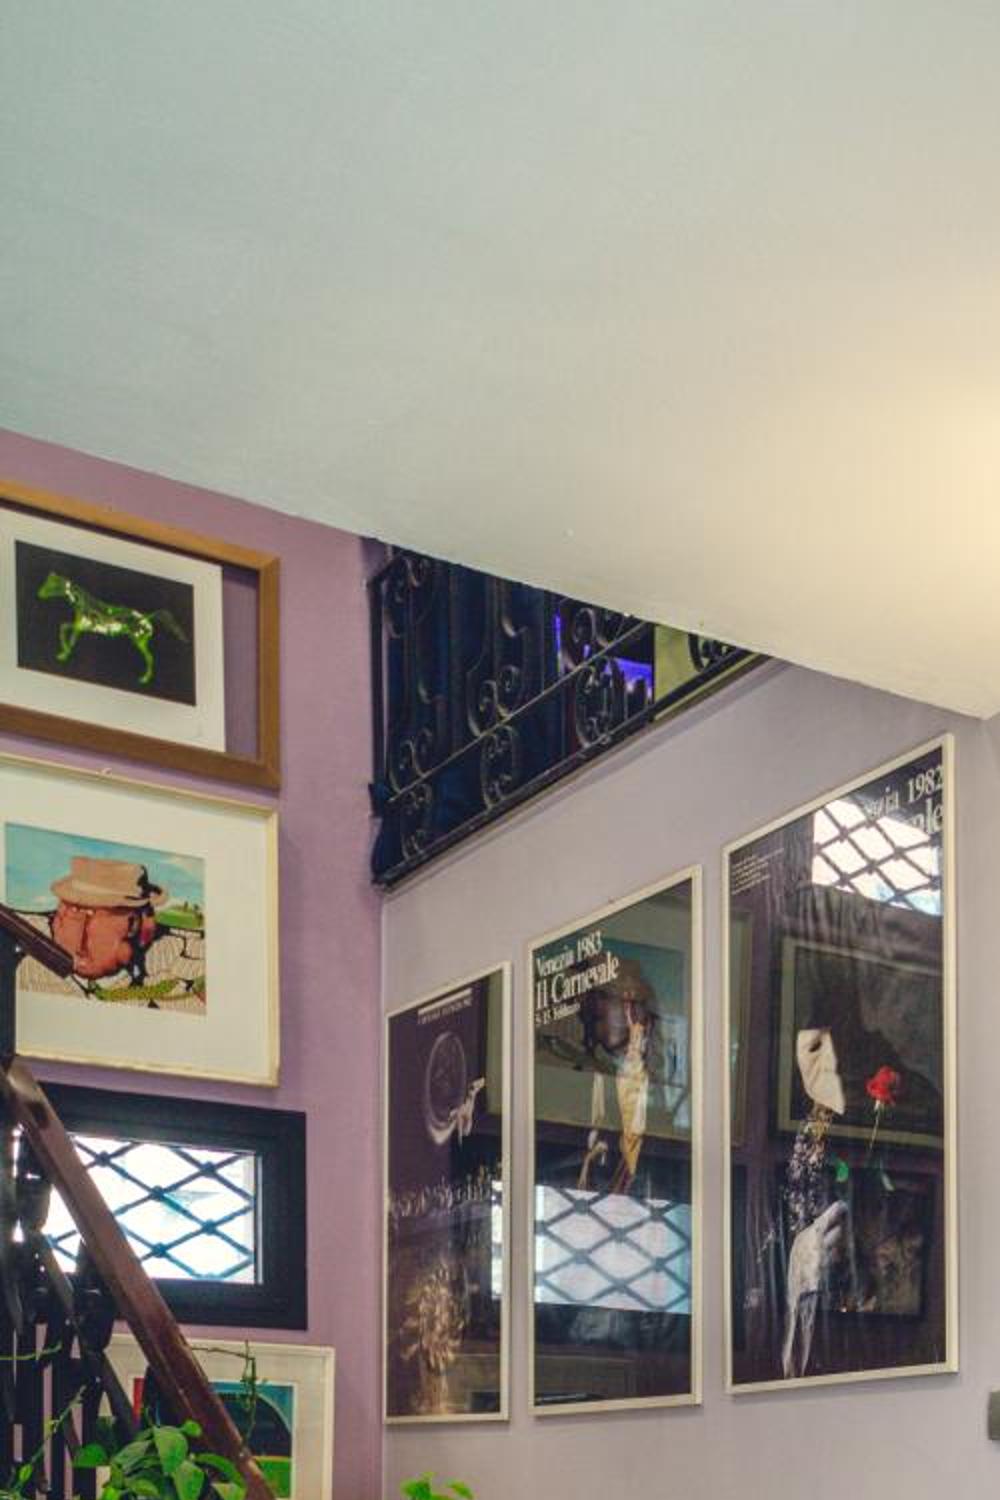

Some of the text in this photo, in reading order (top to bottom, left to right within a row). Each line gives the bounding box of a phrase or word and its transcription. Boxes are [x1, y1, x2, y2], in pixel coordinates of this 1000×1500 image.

[536, 945, 574, 977] Venezia
[537, 951, 620, 1009] Il Carnevale
